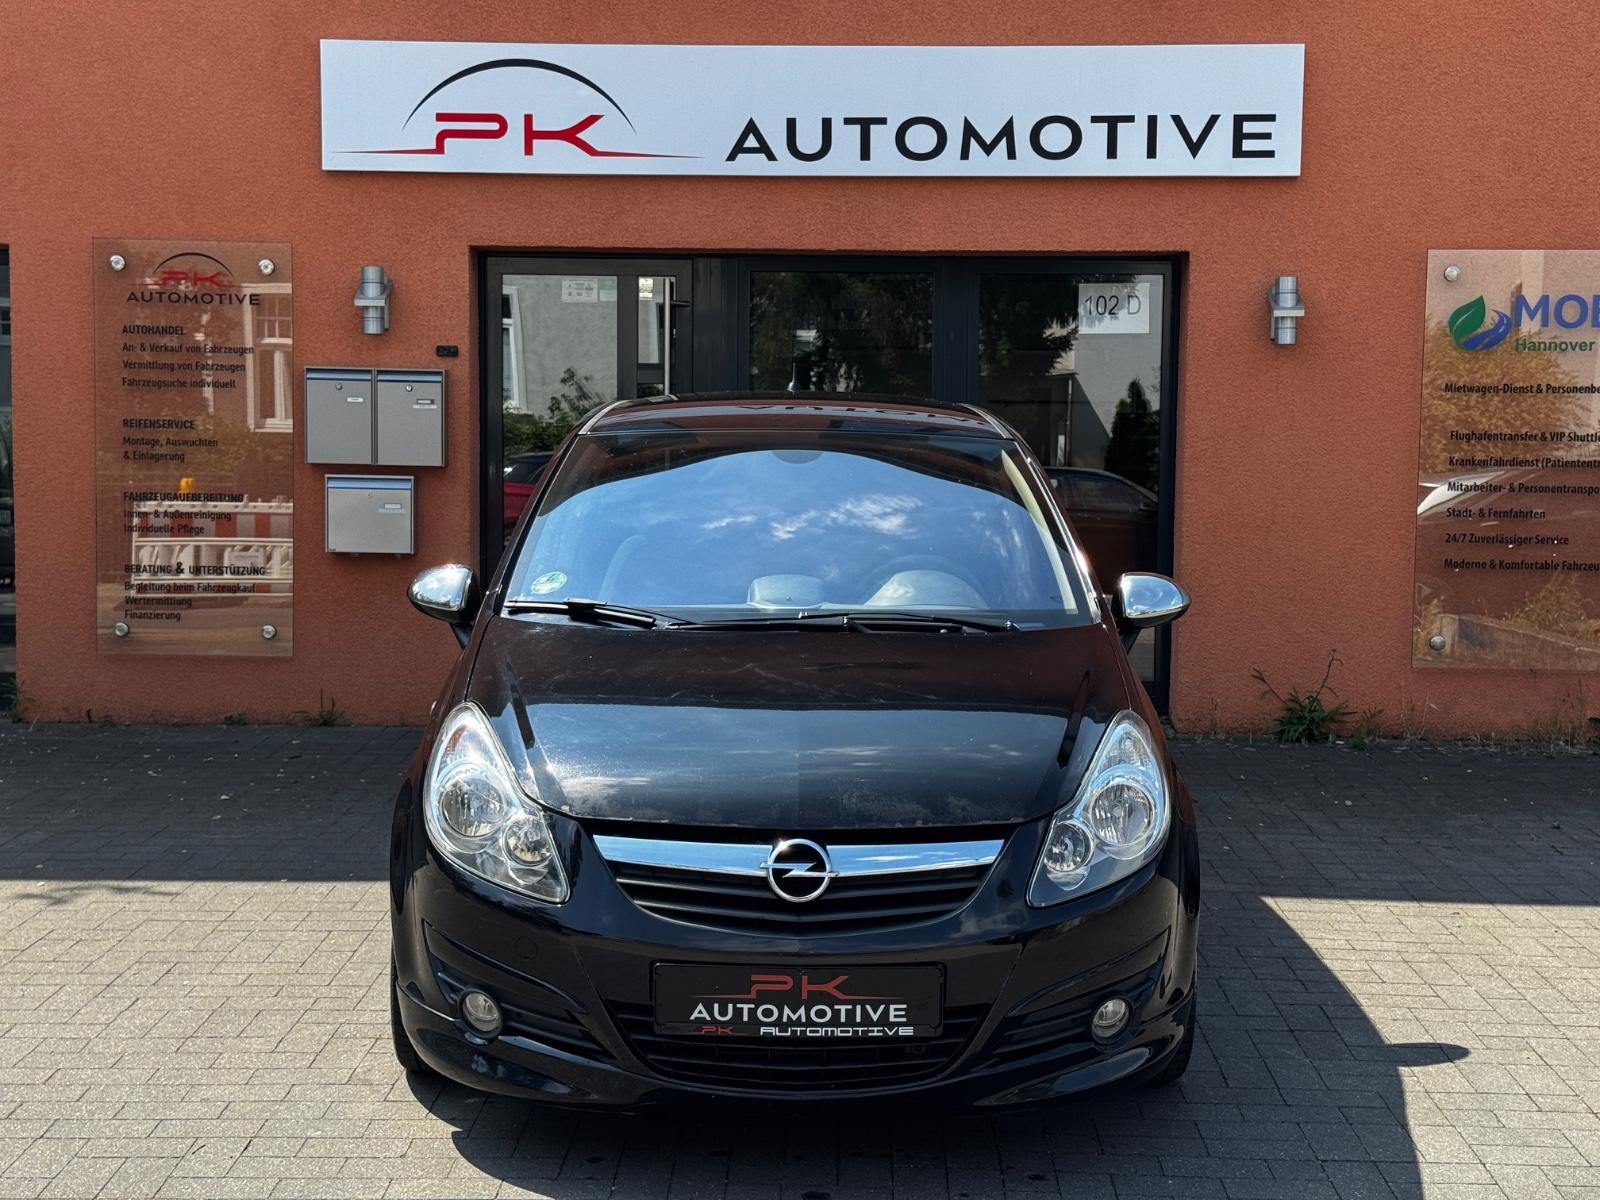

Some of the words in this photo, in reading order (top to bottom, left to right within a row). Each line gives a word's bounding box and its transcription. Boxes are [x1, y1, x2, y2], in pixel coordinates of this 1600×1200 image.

[725, 112, 1277, 162] AUTOMOTIVE
[126, 291, 261, 306] AUTOMOTIVE
[1085, 295, 1120, 316] 102
[1128, 294, 1142, 315] D
[122, 325, 186, 336] AUTOHANDEL
[122, 343, 137, 352] An-
[140, 343, 146, 352] &
[150, 344, 183, 353] Verkauf
[204, 345, 254, 356] Fahrzeugen
[1515, 338, 1596, 352] Hannover
[122, 360, 175, 372] Vermittlung
[195, 361, 246, 373] Fahrzeugen
[122, 377, 188, 389] Fahrzeugsuche
[190, 379, 236, 389] individuell
[1444, 383, 1534, 396] Mietwagen-Dienst
[1536, 384, 1543, 394] &
[123, 418, 195, 430] REIFENSERVICE
[123, 437, 162, 448] Montage,
[165, 437, 218, 448] Auswuchten
[1450, 430, 1537, 444] Flughafentransfer
[1540, 432, 1547, 442] &
[1550, 432, 1565, 442] VIP
[133, 452, 185, 463] Einlagerung
[1449, 457, 1539, 468] Krankenfahrdienst
[1447, 482, 1507, 493] Mitarbeiter-
[1508, 483, 1516, 493] &
[1518, 483, 1600, 497] Personentranspo
[124, 491, 243, 502] FAHRZEUGAUFBEREITUNG
[124, 510, 151, 518] Innen-
[163, 510, 231, 521] Außenreinigung
[1446, 508, 1476, 518] Stadt-
[1478, 508, 1486, 518] &
[1488, 508, 1546, 518] Fernfahrten
[124, 524, 175, 533] Individuelle
[178, 525, 205, 535] Pflege
[1445, 533, 1467, 543] 24/7
[1469, 533, 1532, 546] Zuverlässiger
[1534, 535, 1569, 545] Service
[124, 564, 172, 574] BERATUNG
[175, 561, 185, 574] &
[189, 563, 266, 575] UNTERSTÜTZUNG
[1444, 558, 1487, 569] Moderne
[1488, 559, 1496, 569] &
[1499, 559, 1560, 570] Komfortable
[1562, 560, 1600, 572] Fahrzeu
[124, 582, 171, 593] Begleitung
[173, 582, 194, 591] beim
[197, 583, 255, 594] Fahrzeugkauf
[125, 596, 192, 608] Wertermittlung
[125, 610, 181, 622] Finanzierung
[750, 974, 849, 1000] PK
[690, 1002, 907, 1023] AUTOMOTIVE
[700, 1026, 736, 1035] PK
[760, 1026, 915, 1037] AUTOMOTIVE
